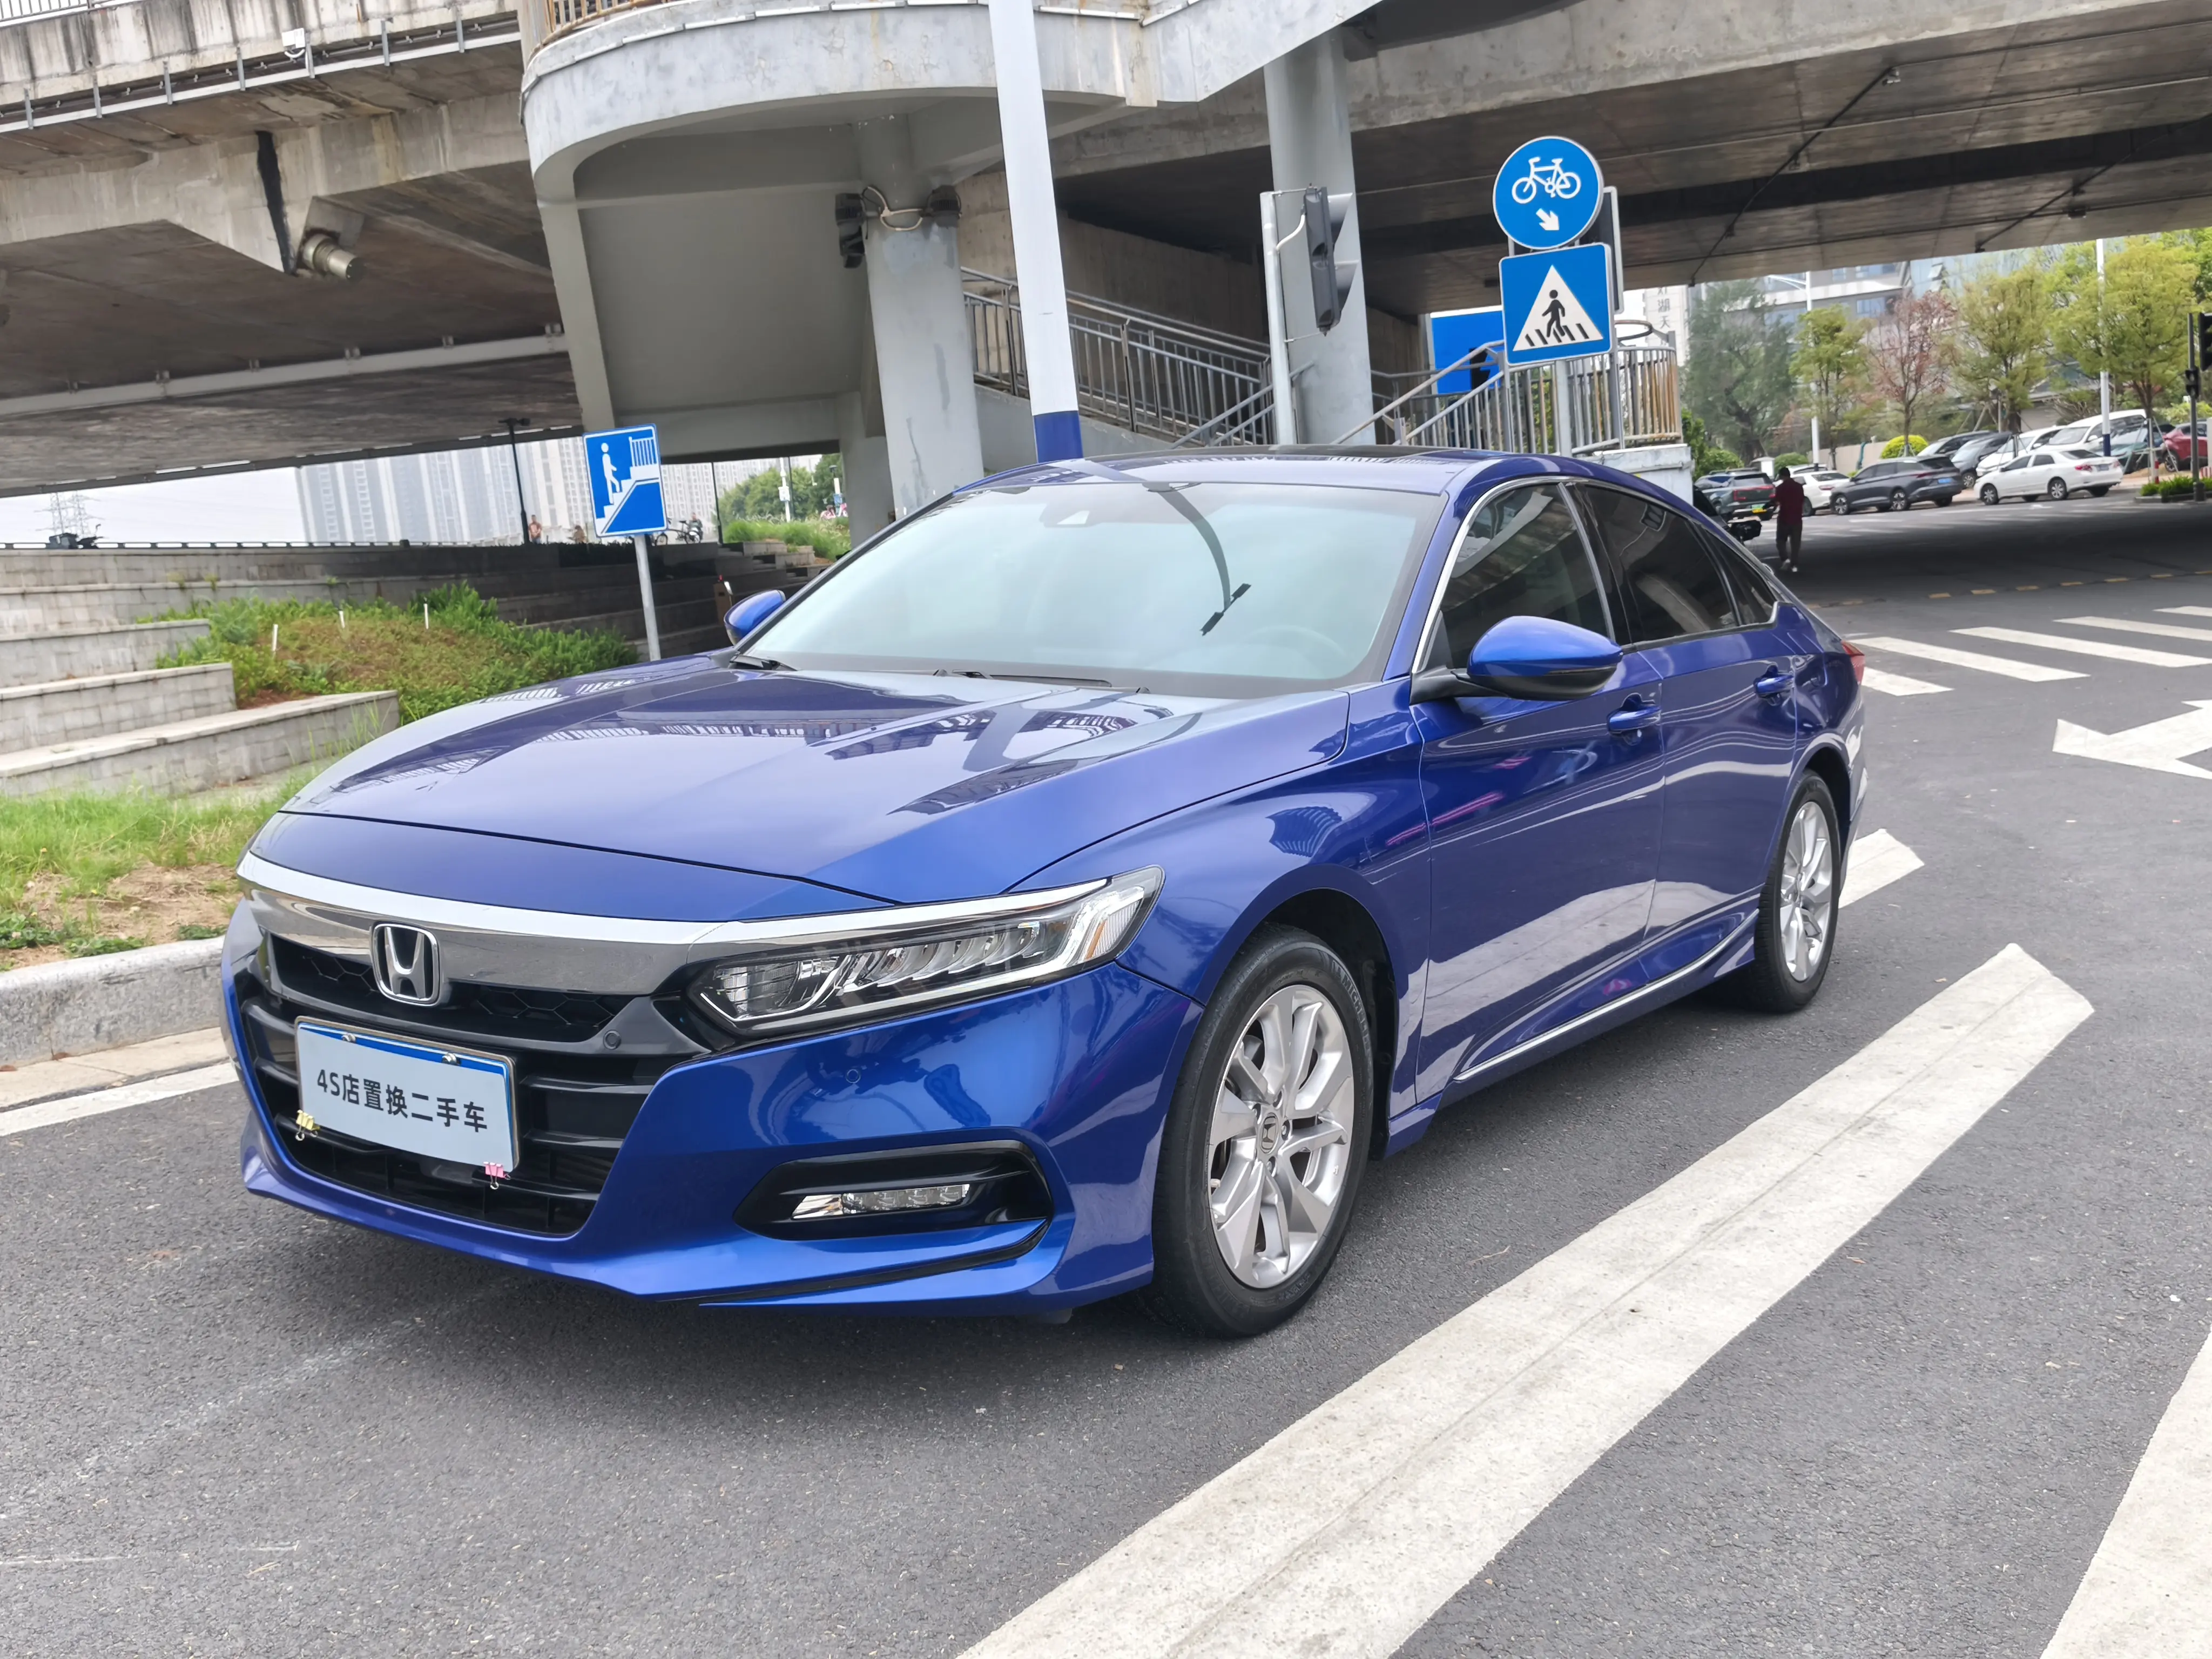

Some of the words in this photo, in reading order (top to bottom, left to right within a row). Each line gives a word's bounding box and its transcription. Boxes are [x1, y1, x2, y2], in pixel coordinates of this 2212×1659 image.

[317, 1069, 487, 1132] 4S店置换二手车
